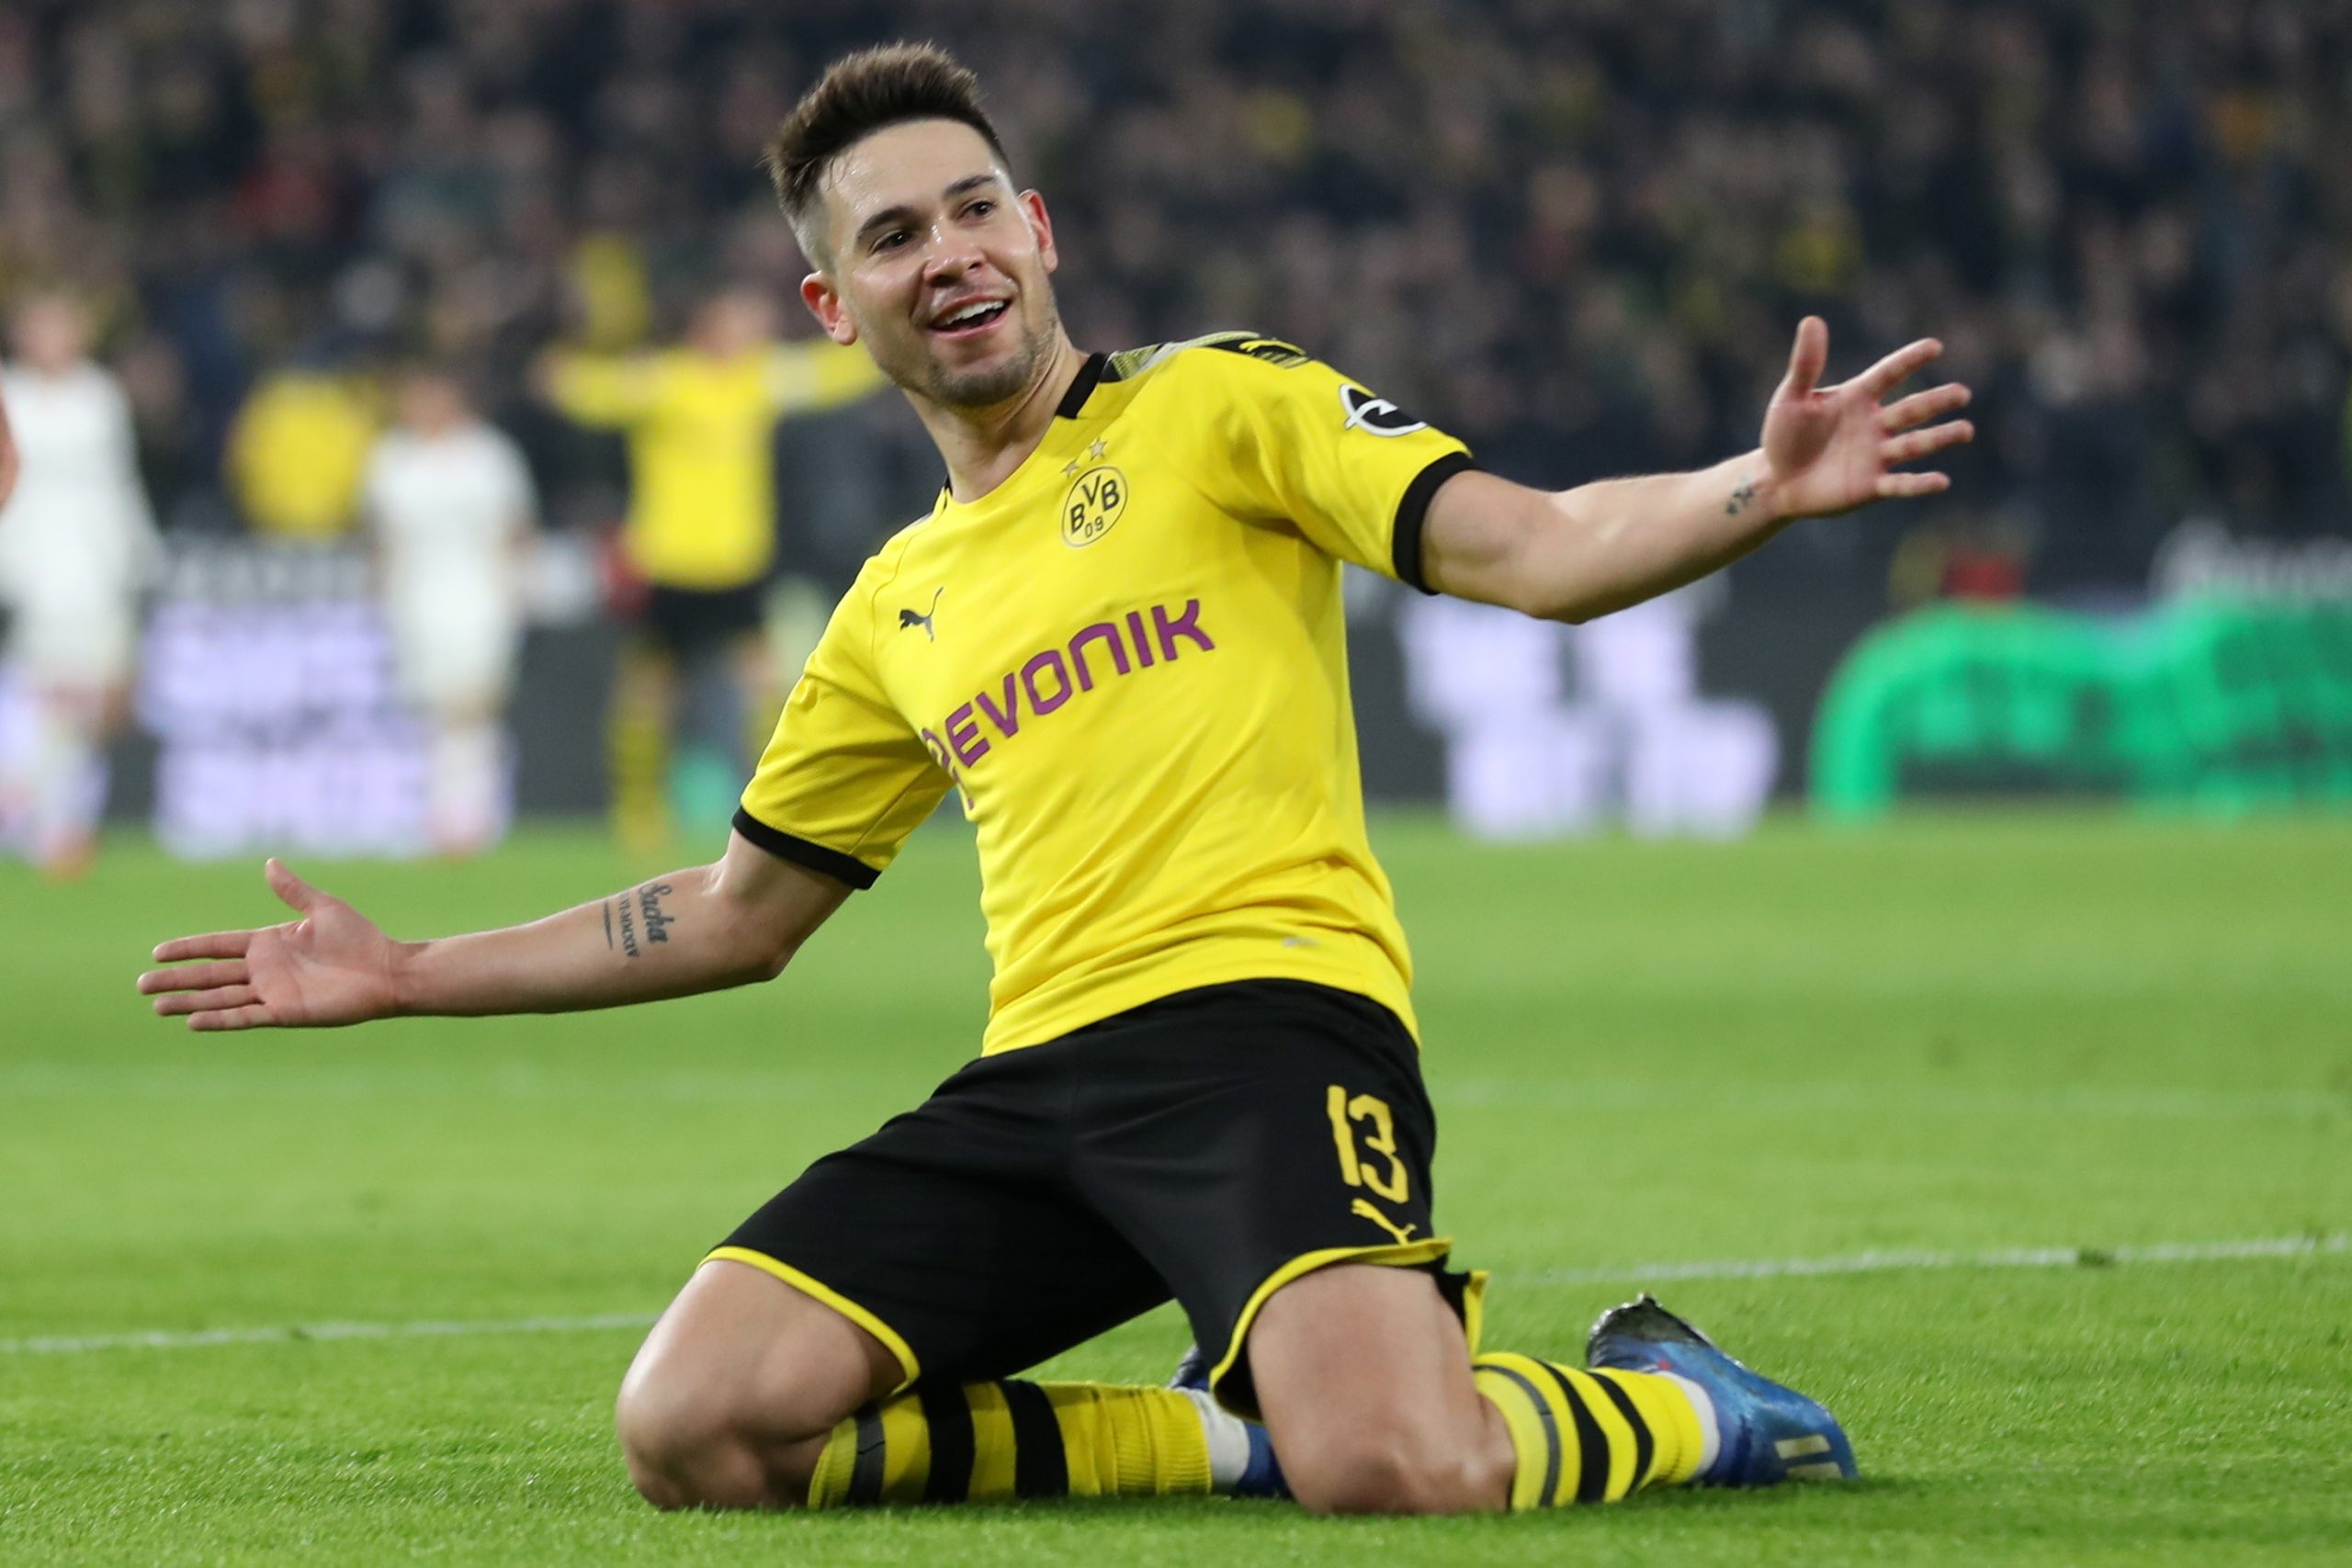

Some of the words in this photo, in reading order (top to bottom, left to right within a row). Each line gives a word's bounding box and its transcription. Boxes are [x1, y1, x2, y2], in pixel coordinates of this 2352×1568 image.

[1069, 474, 1120, 535] BVB
[1084, 515, 1104, 538] 09
[945, 599, 1215, 768] EVONIK
[1327, 1085, 1408, 1203] 13
